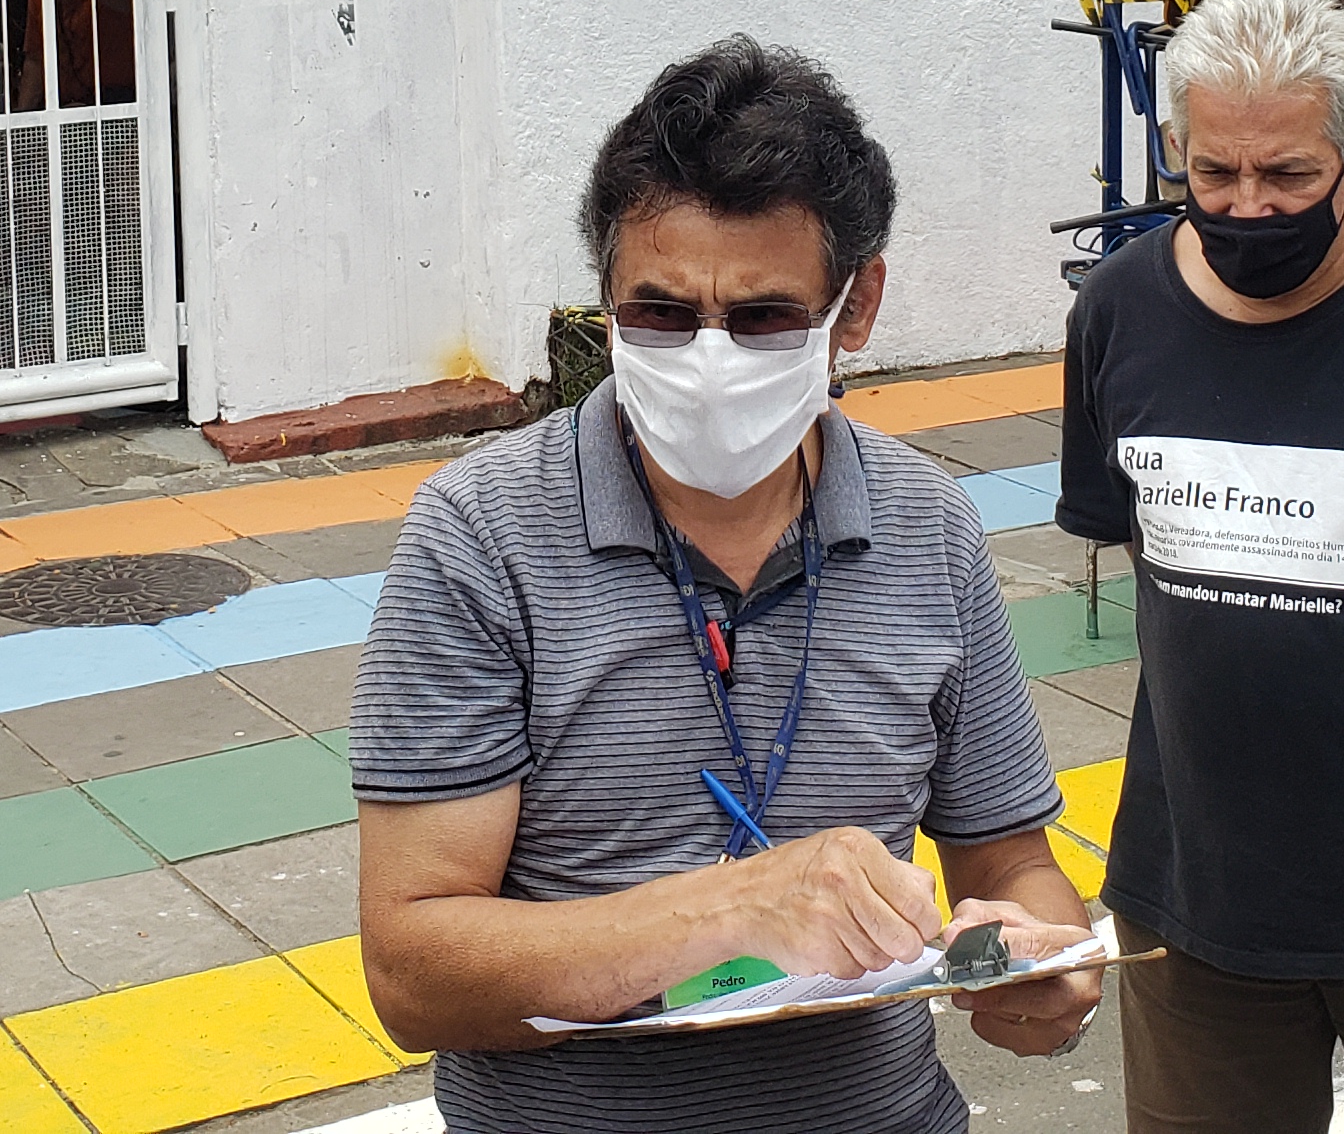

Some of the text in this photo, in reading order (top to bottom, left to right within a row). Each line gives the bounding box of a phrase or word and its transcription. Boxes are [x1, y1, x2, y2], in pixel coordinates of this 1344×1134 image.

[1124, 446, 1163, 471] Rua
[1224, 486, 1315, 519] Franco
[1169, 524, 1212, 539] Vereadora,
[1214, 531, 1260, 543] defensora
[1262, 534, 1280, 544] dos
[1281, 536, 1321, 550] Direitos
[1178, 538, 1239, 552] covardemente
[1241, 544, 1299, 559] assassinada
[1301, 551, 1314, 561] no
[1316, 551, 1333, 563] dia
[1171, 584, 1218, 602] mandou
[1221, 591, 1268, 609] matar
[1270, 593, 1342, 614] Marielle?
[712, 976, 746, 988] Pedro
